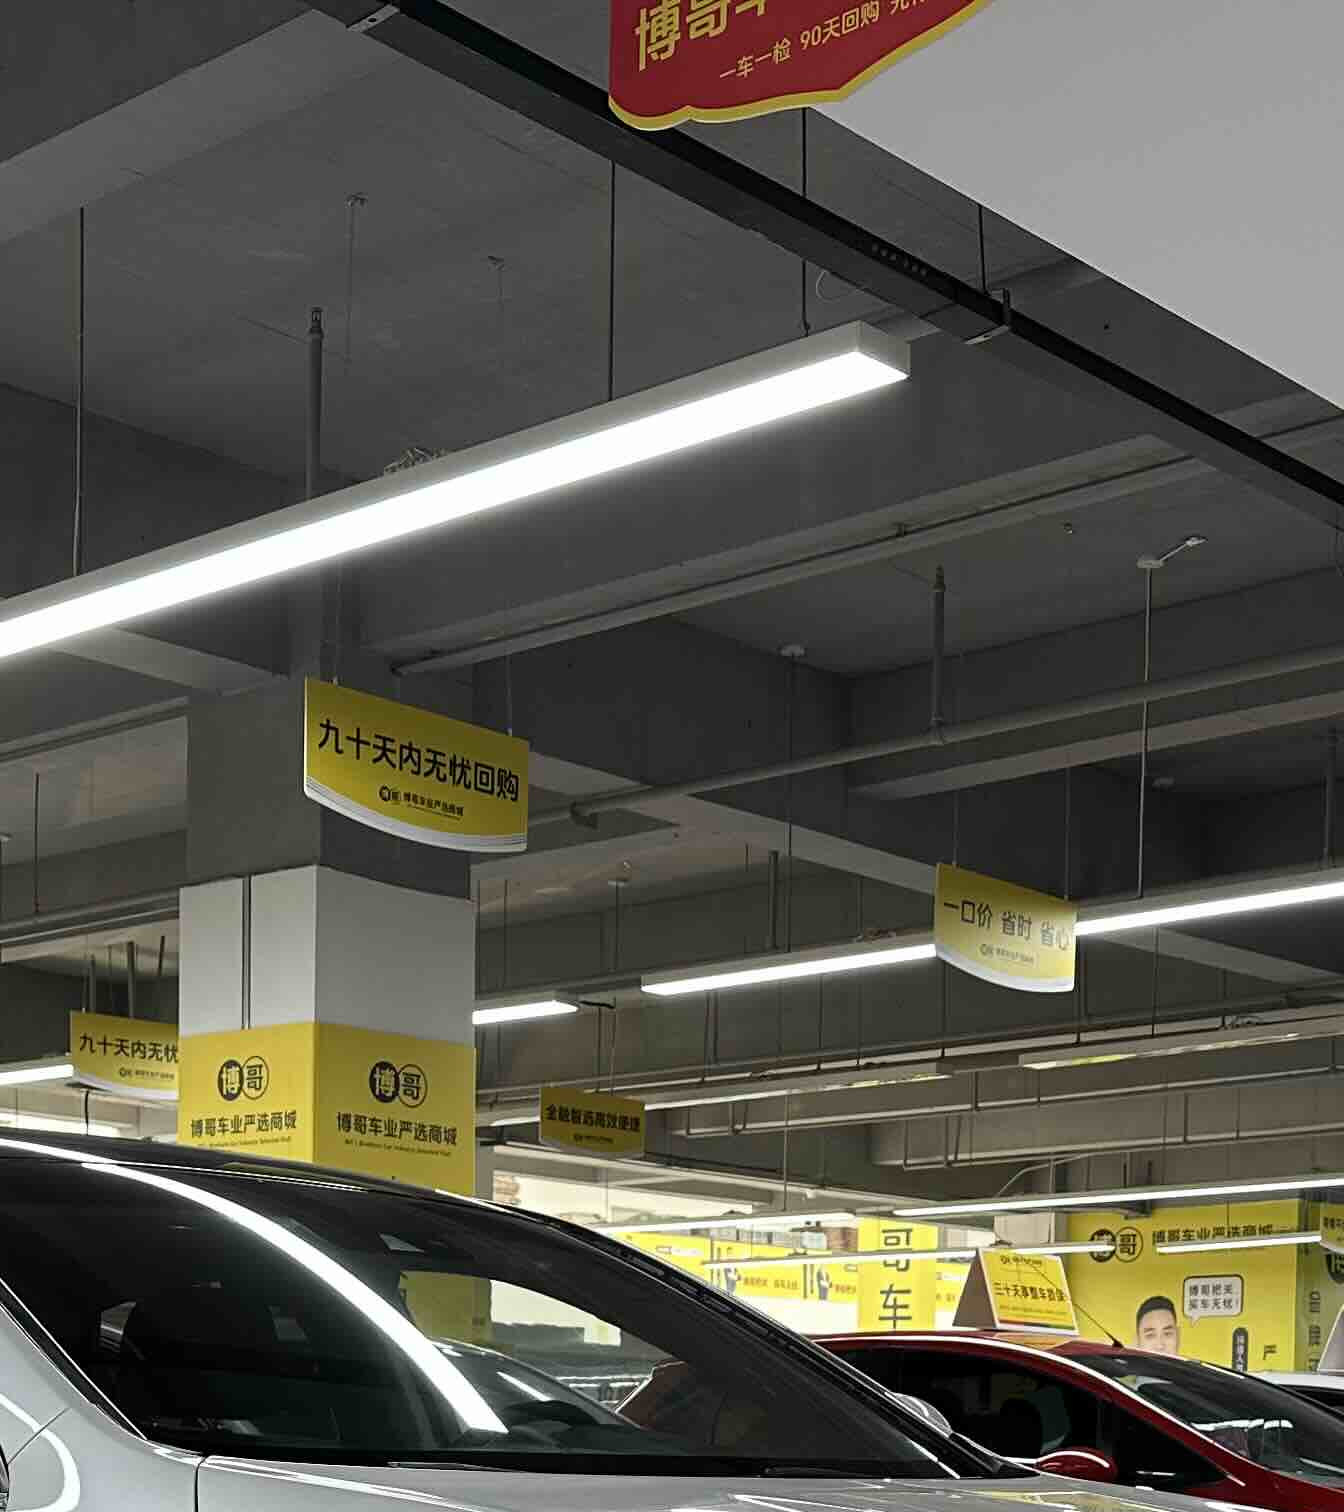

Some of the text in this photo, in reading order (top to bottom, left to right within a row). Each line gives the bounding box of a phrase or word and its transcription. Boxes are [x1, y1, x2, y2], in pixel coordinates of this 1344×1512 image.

[719, 2, 879, 79] 一车一检 90天回购
[318, 718, 519, 802] 九十天内无忧回购
[943, 899, 1071, 951] 一口价 省时 省心
[79, 1032, 178, 1064] 九十天内无忧
[219, 1060, 266, 1098] 博哥
[371, 1065, 425, 1104] 博哥
[190, 1111, 297, 1138] 博哥车业严选商城
[337, 1112, 457, 1145] 博哥车业严选商城
